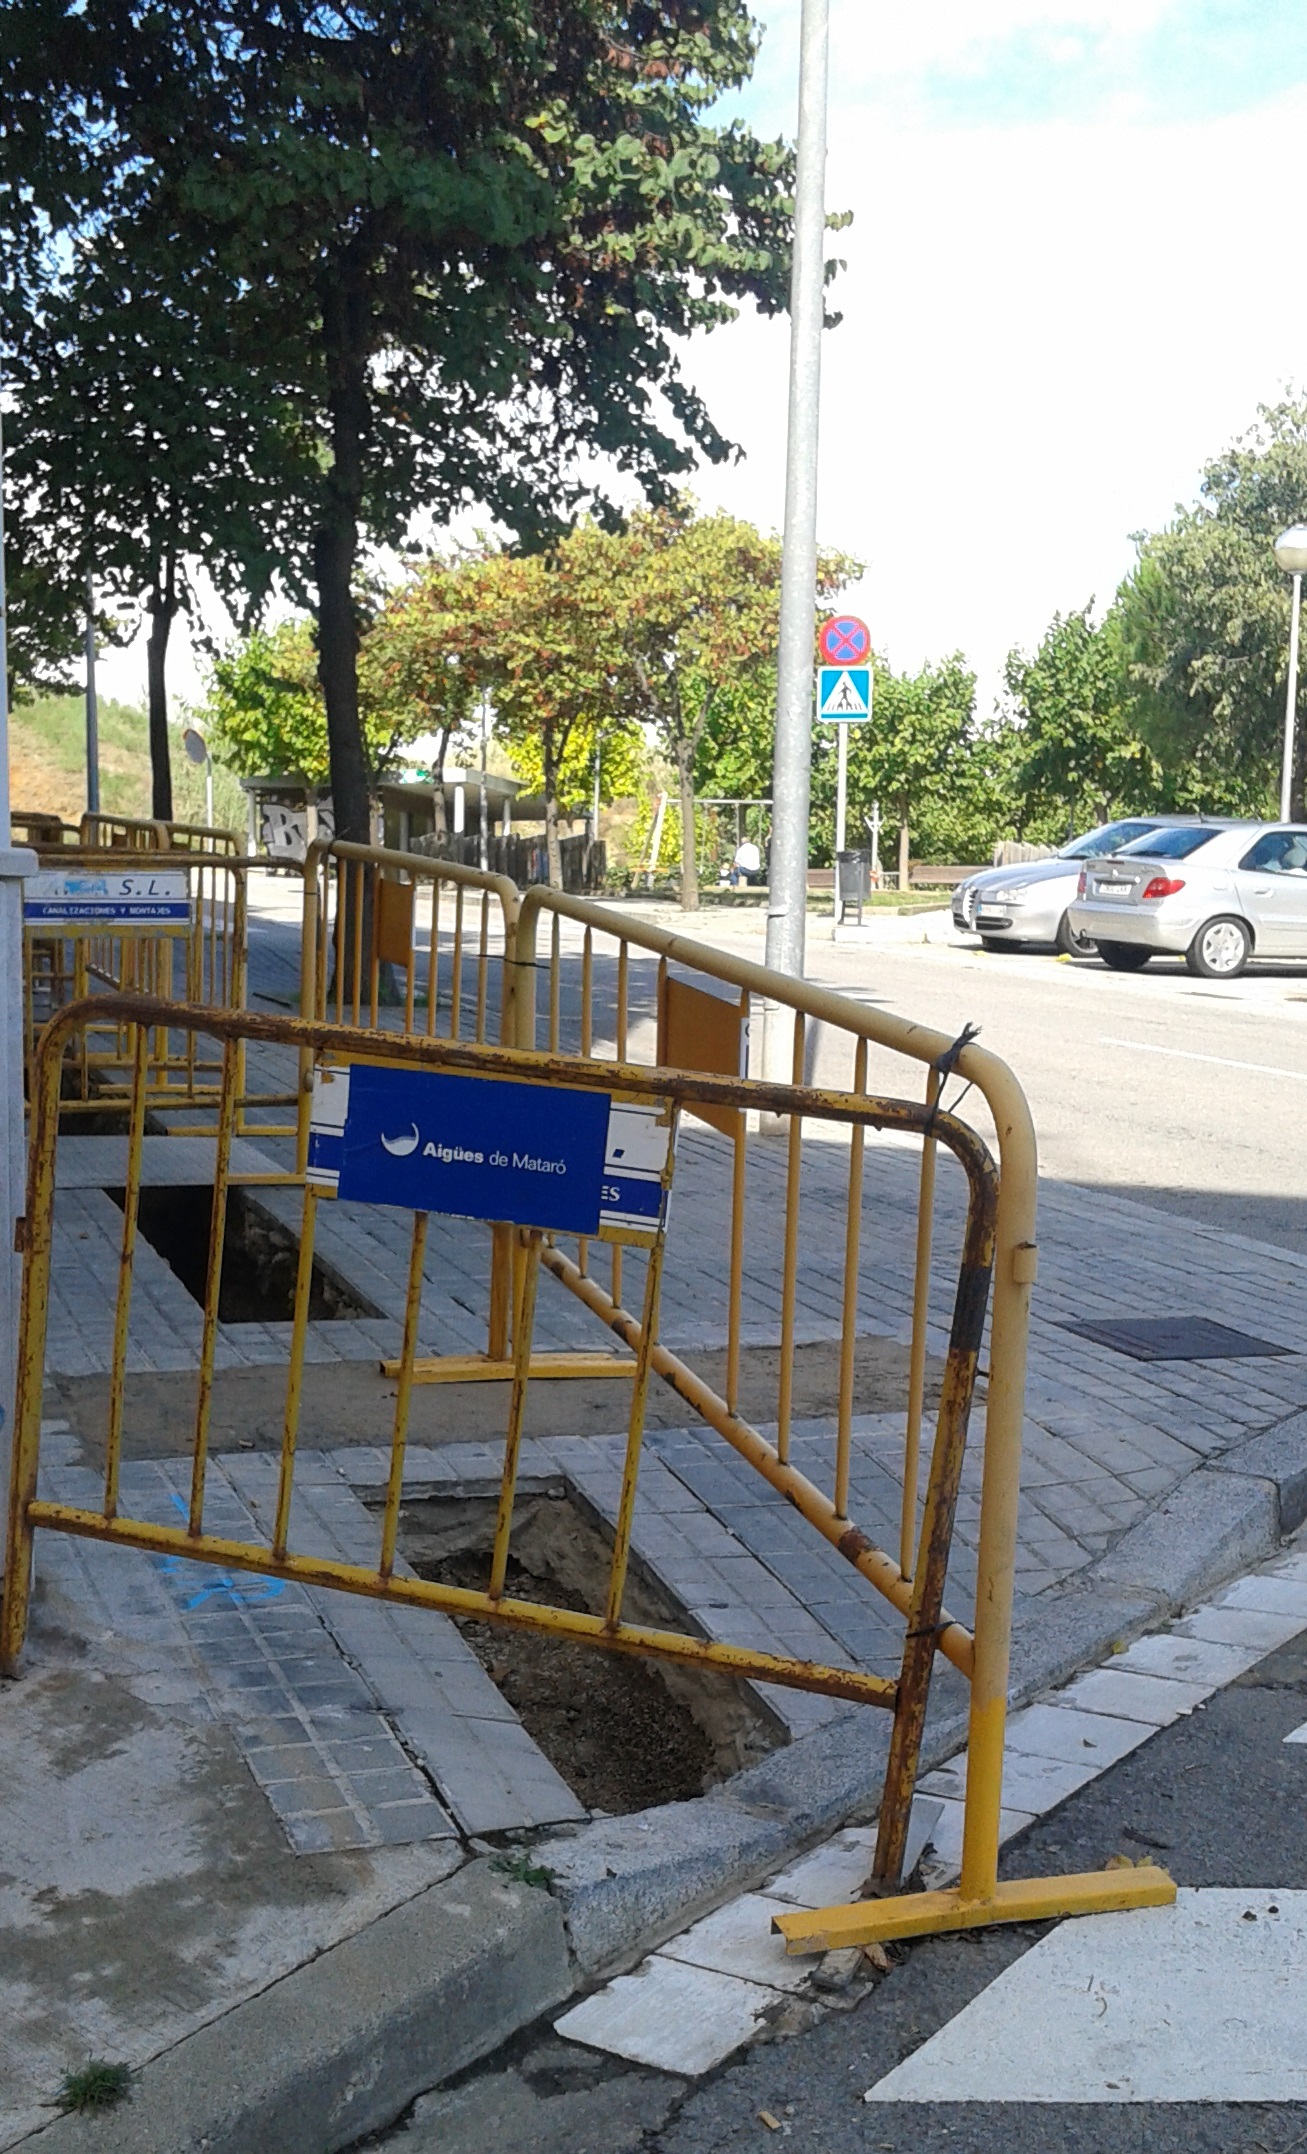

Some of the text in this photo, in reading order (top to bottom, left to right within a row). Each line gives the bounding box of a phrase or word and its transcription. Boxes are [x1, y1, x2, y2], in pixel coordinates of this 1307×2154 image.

[422, 1142, 567, 1175] Aigües de Mataró
